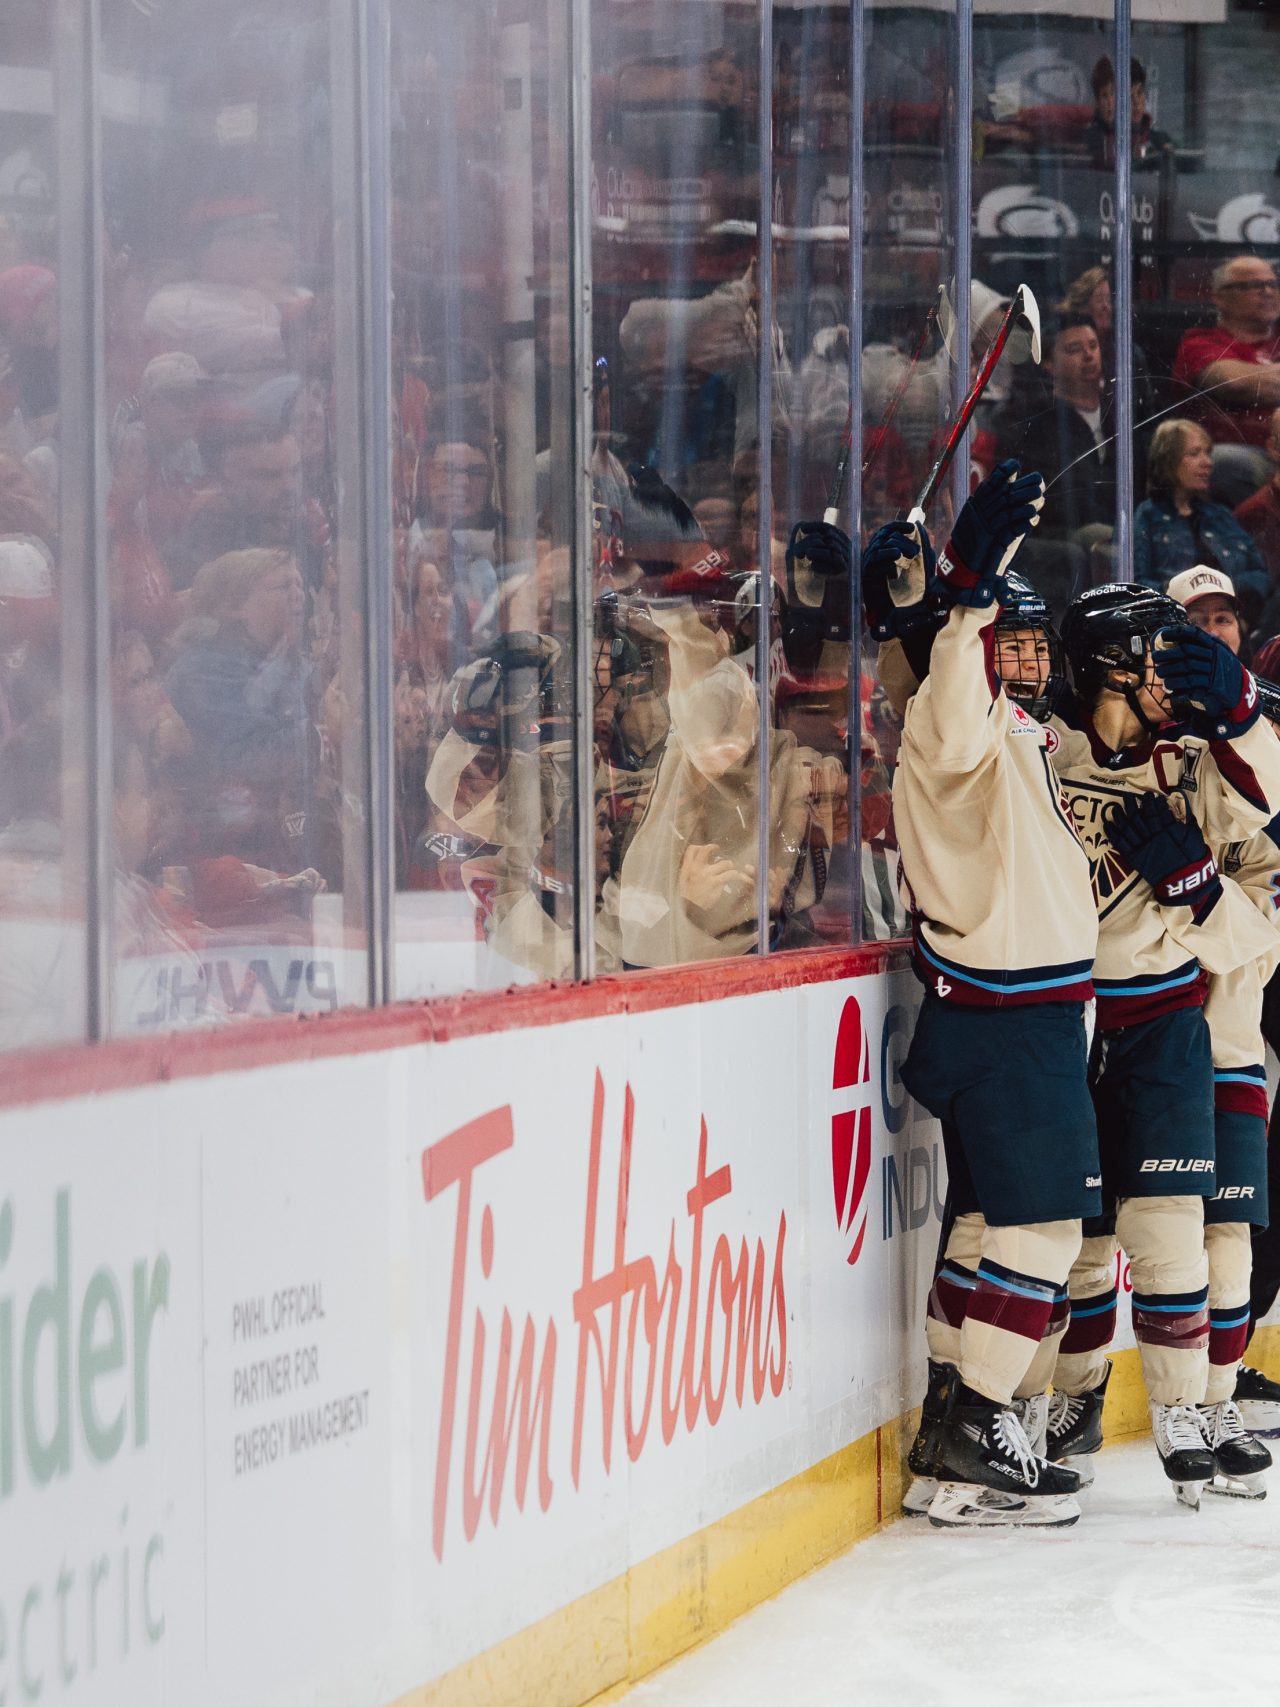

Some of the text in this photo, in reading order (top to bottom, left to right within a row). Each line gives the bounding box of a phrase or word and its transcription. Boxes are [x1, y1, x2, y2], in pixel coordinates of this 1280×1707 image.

[1090, 585, 1128, 598] ROGERS
[1096, 654, 1118, 666] AUER
[233, 1281, 325, 1342] PWHL OFFICIAL
[421, 1065, 788, 1564] Tim Hortons
[234, 1345, 319, 1408] PARTNER FOR
[234, 1388, 369, 1475] ENERGY MANAGEMENT
